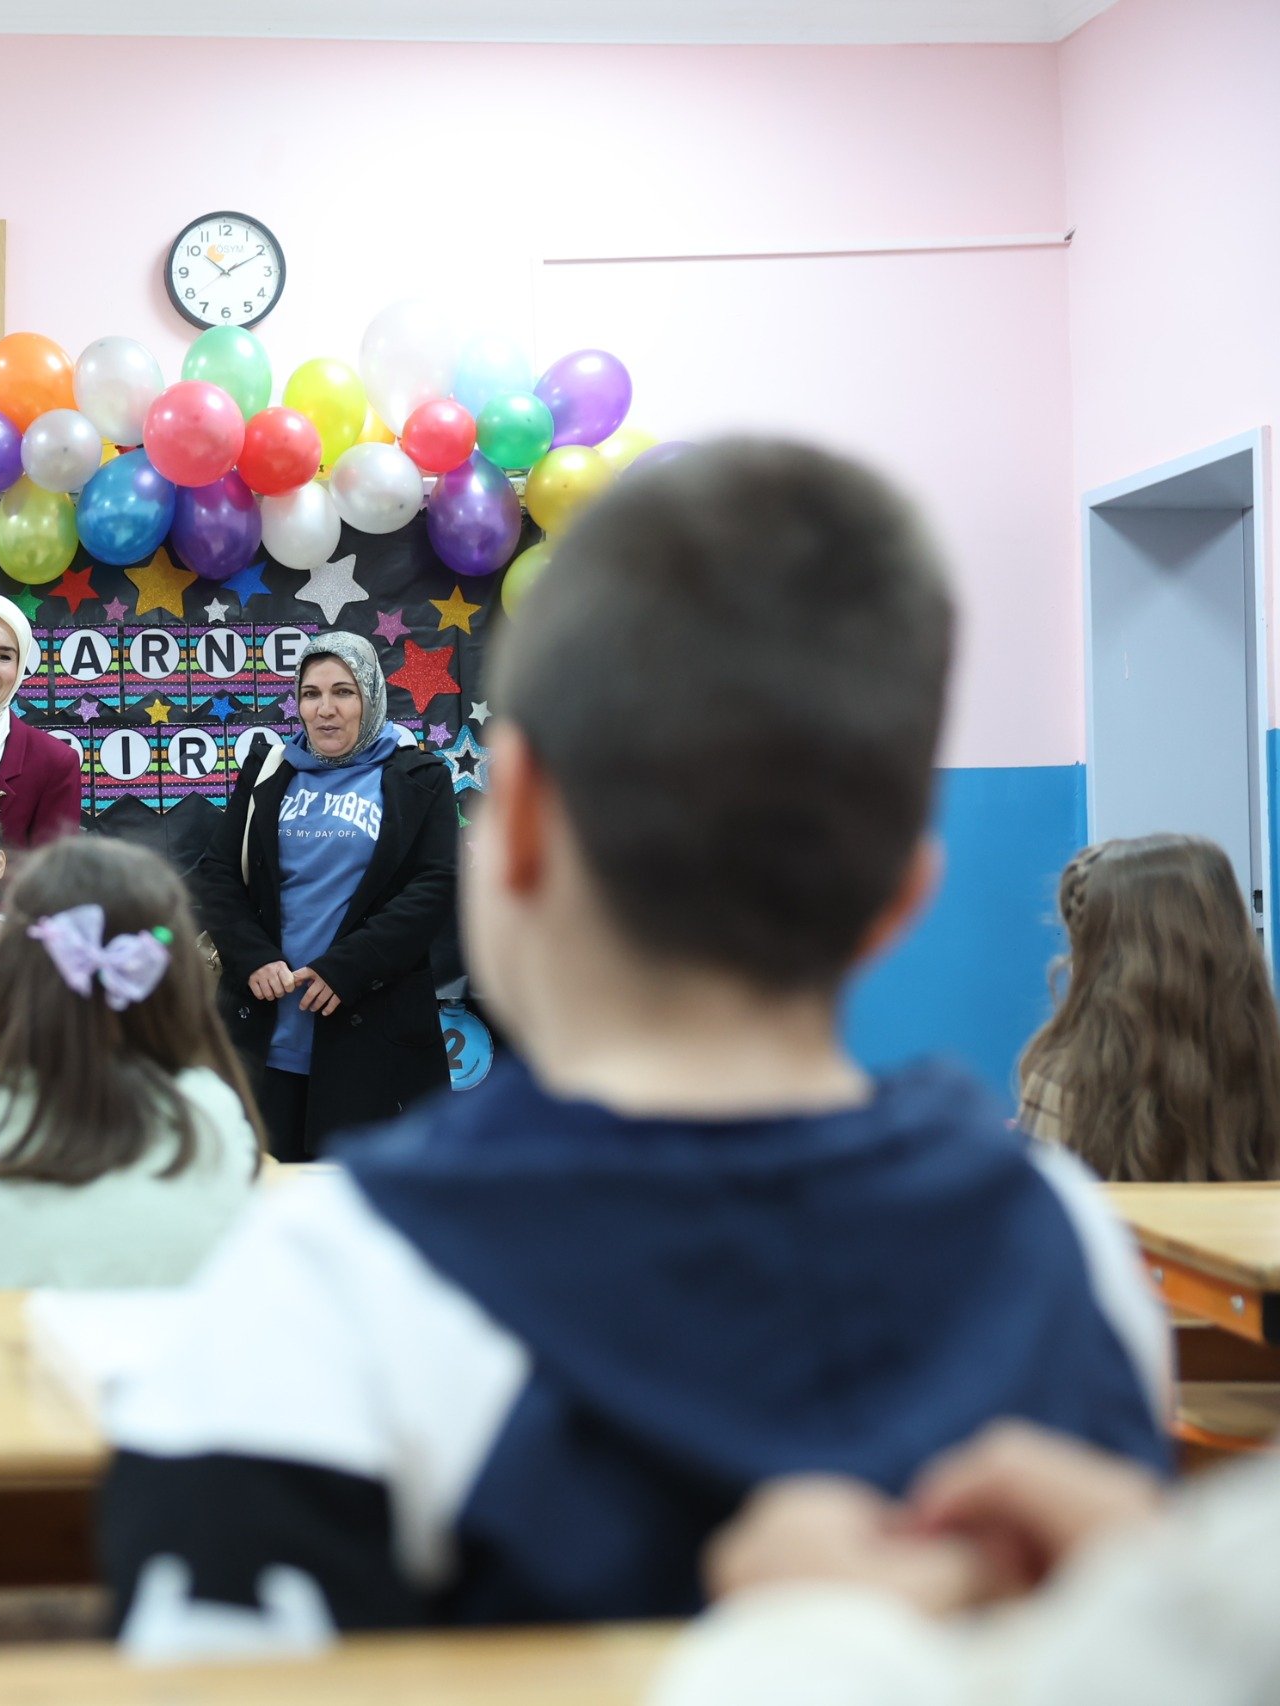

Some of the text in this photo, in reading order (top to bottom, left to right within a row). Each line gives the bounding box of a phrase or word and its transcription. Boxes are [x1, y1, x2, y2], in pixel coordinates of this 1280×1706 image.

[201, 230, 209, 242] 11
[219, 224, 232, 236] 12
[186, 245, 201, 257] 10
[255, 244, 266, 256] 2
[178, 266, 189, 279] 9
[263, 265, 273, 278] 3
[184, 287, 196, 299] 8
[256, 287, 267, 298] 4
[199, 301, 209, 314] 7
[220, 306, 232, 319] 6
[243, 301, 253, 313] 5
[22, 633, 301, 676] ARNE
[322, 791, 382, 842] VIBES
[296, 829, 310, 838] MY
[315, 830, 333, 838] DAY
[338, 829, 357, 838] OFF
